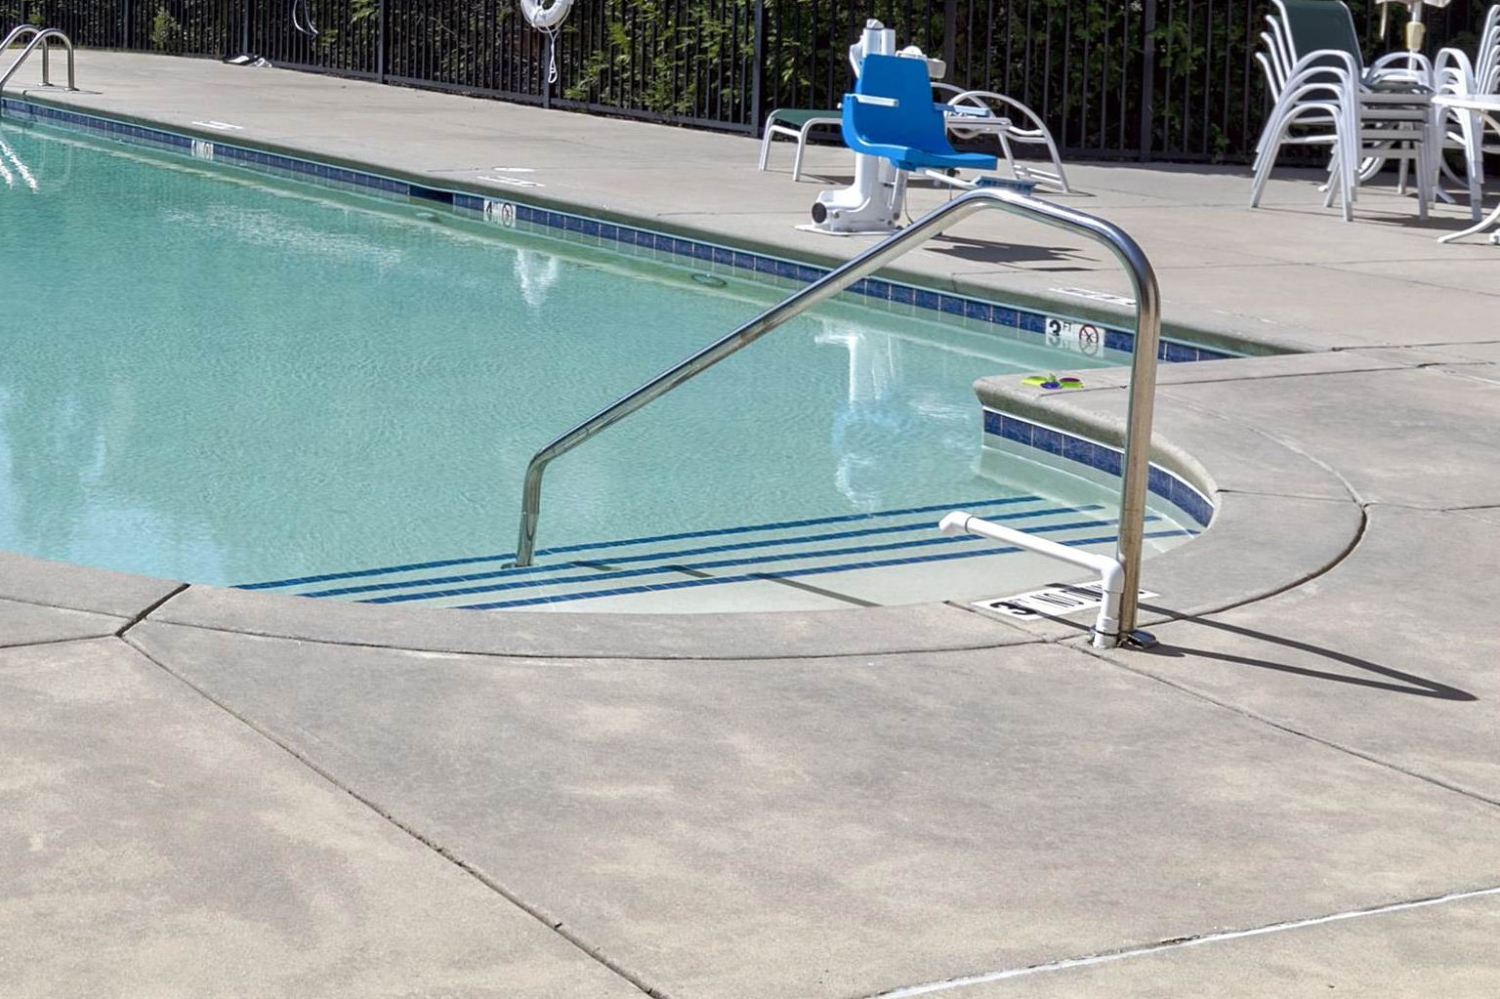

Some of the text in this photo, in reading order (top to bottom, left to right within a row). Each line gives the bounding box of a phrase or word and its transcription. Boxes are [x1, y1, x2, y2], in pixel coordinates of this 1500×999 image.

[1049, 319, 1072, 337] 3 FT
[989, 601, 1037, 616] 3
